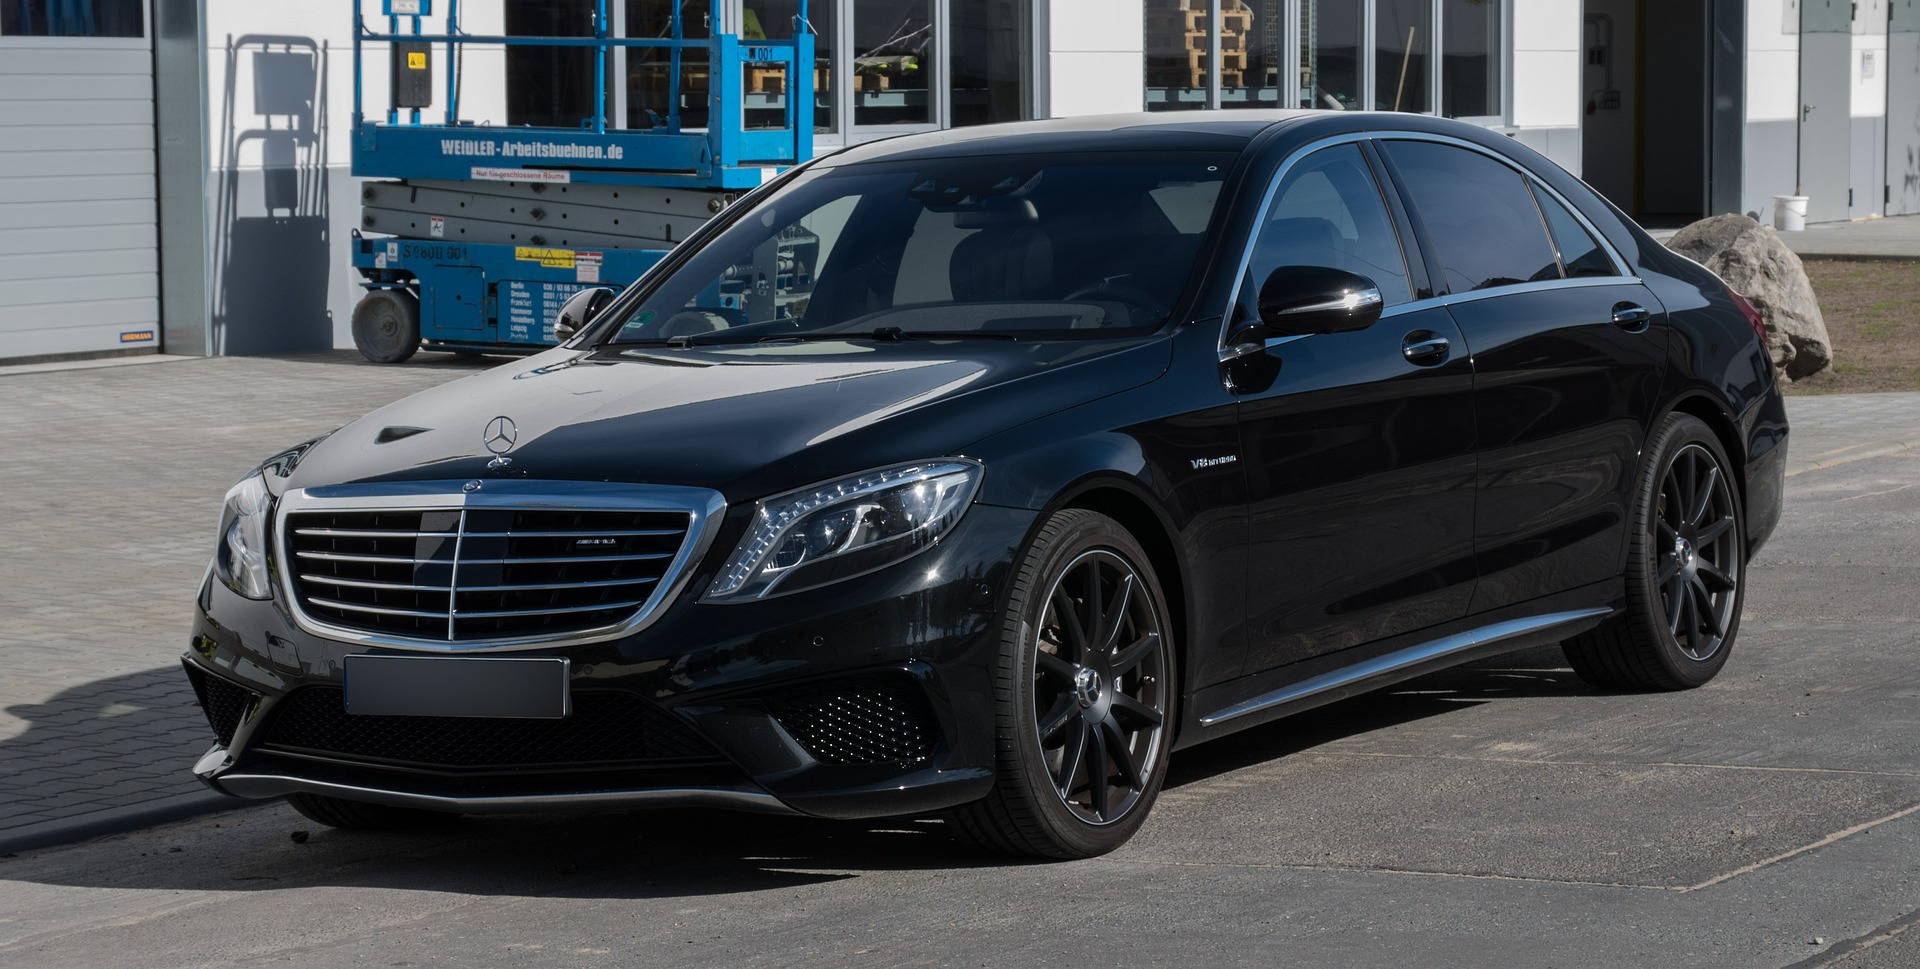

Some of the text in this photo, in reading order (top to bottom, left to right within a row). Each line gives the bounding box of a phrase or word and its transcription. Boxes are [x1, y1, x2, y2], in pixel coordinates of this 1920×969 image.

[758, 47, 773, 61] 001
[476, 169, 487, 177] Nur
[499, 170, 542, 180] geschlossene
[543, 170, 565, 180] Räume
[511, 290, 530, 298] Dresden
[511, 299, 532, 307] Frankfurt
[511, 316, 535, 325] Heidelberg
[511, 325, 528, 333] Leipzig
